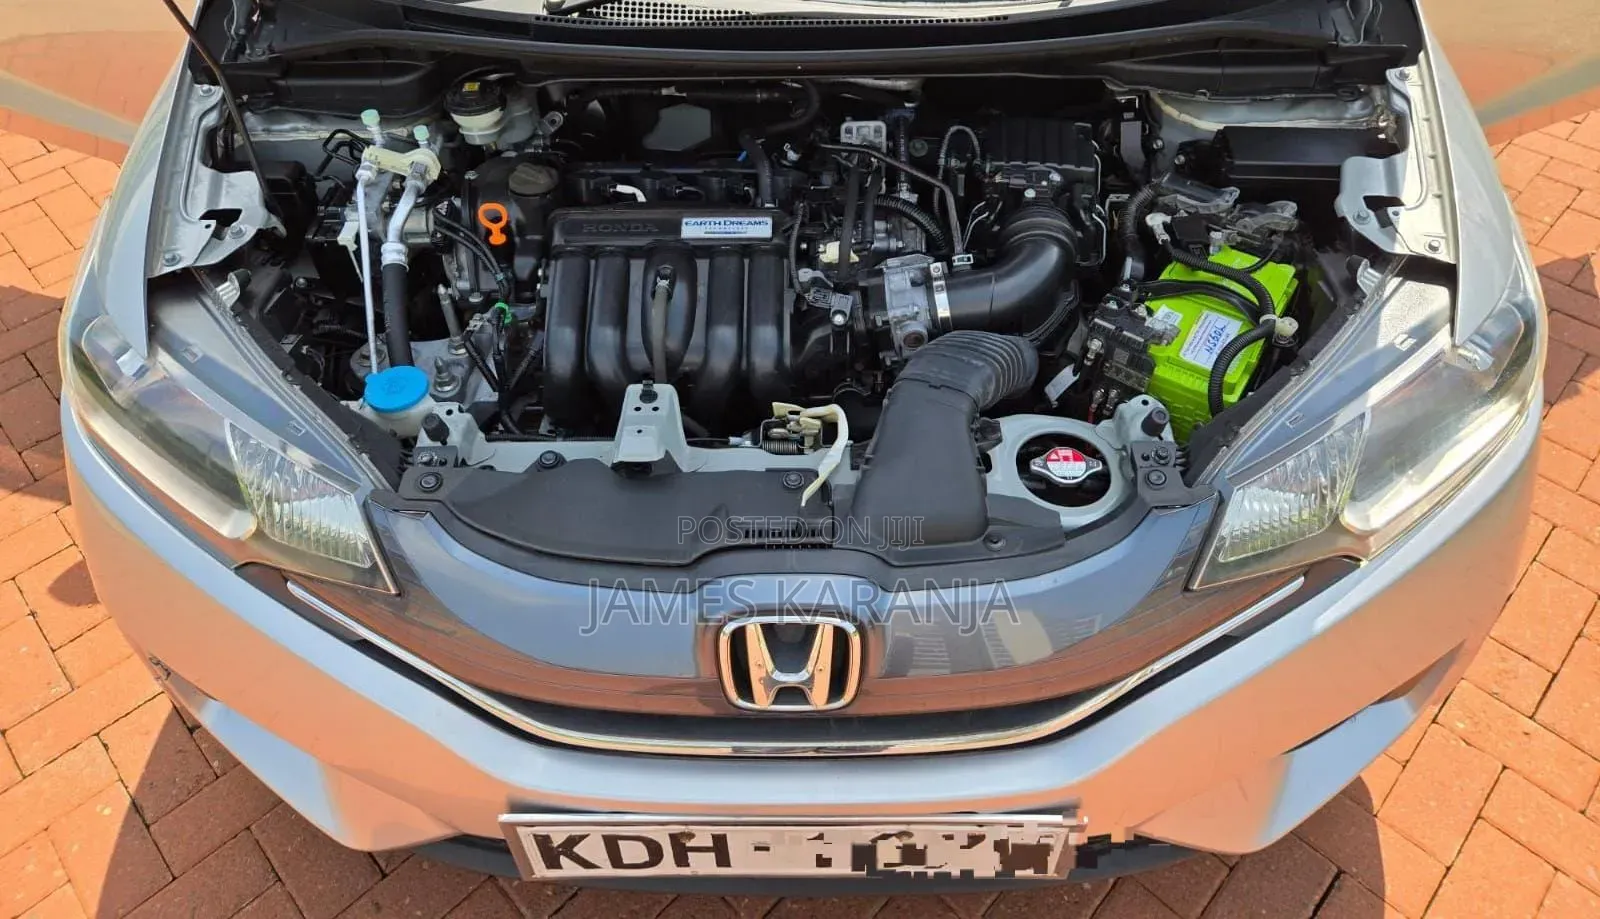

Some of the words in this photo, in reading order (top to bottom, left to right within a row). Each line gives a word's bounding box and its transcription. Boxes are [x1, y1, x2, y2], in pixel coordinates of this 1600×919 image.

[684, 219, 721, 227] EARTH
[723, 219, 769, 227] DREAMS
[532, 832, 732, 870] KDH
